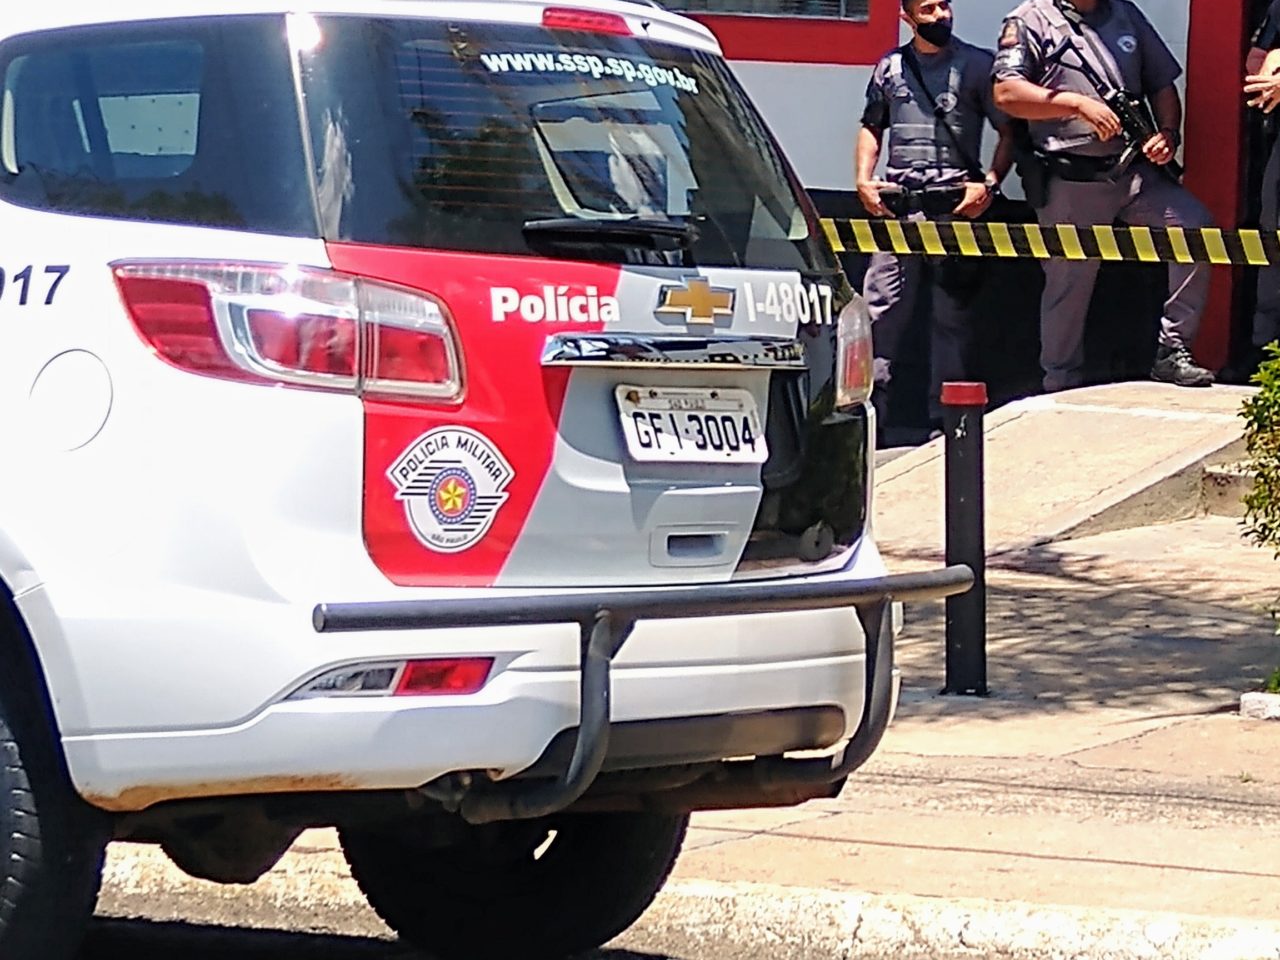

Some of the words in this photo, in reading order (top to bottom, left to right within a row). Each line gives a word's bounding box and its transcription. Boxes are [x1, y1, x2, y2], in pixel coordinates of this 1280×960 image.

[480, 53, 699, 94] www.ssp.sp.gov.br
[0, 264, 71, 306] 17
[490, 286, 621, 324] Polícia
[744, 282, 833, 325] I-48017
[456, 435, 503, 482] MILITAR
